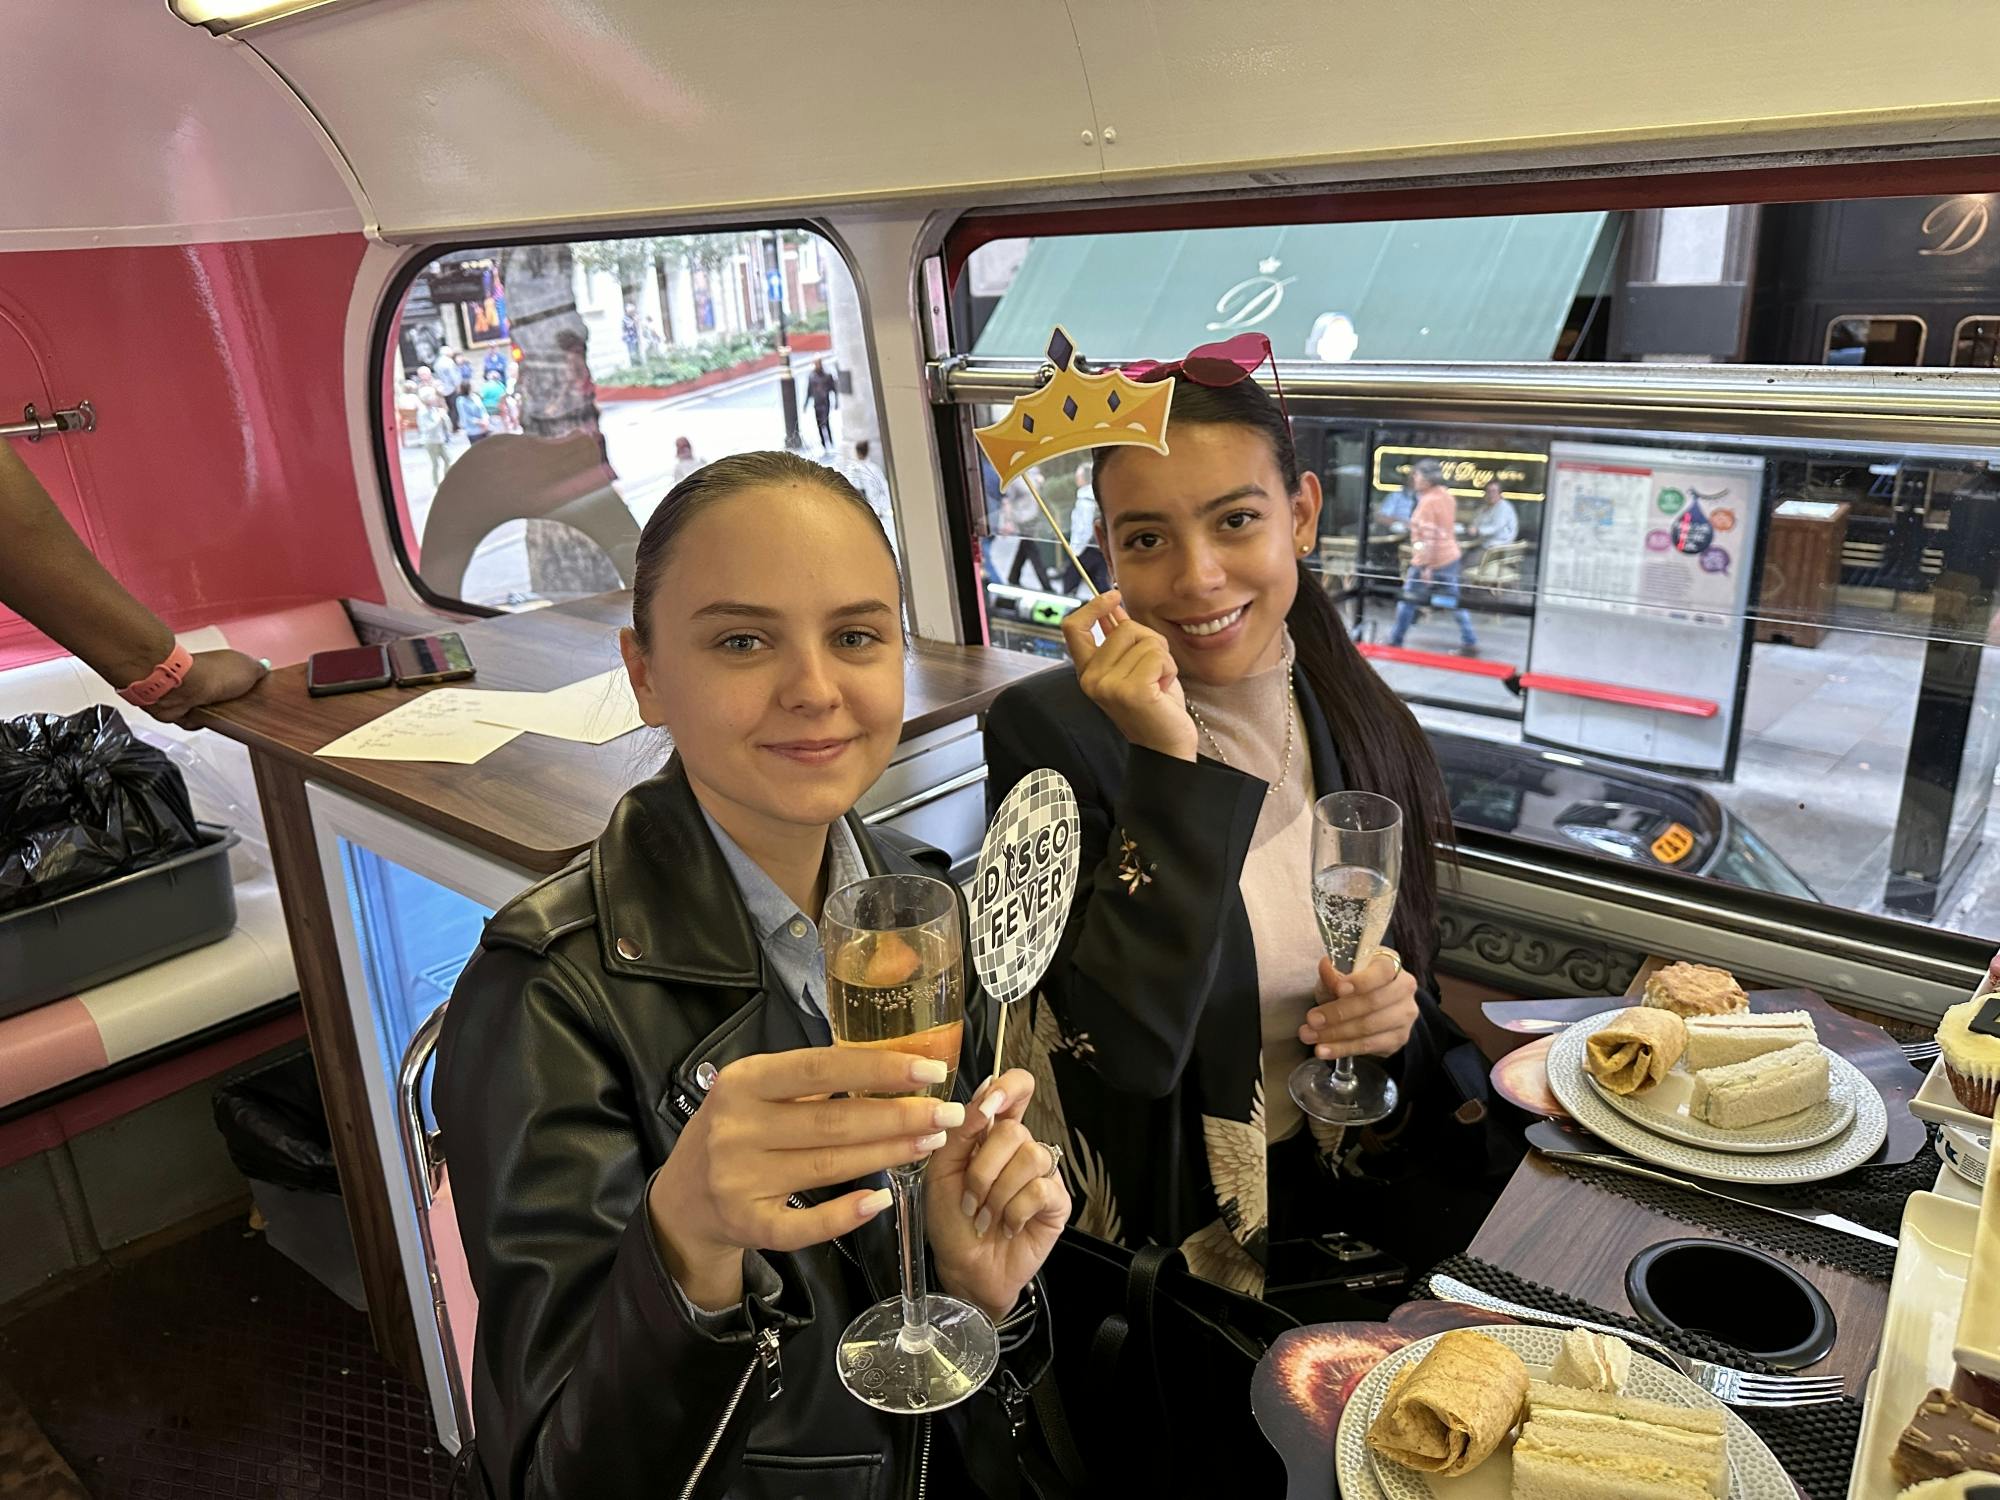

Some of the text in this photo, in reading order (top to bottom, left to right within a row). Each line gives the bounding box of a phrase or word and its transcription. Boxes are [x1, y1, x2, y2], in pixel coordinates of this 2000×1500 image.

[983, 818, 1070, 909] DISCO
[1656, 831, 1689, 858] TAX
[991, 864, 1064, 949] FEVER
